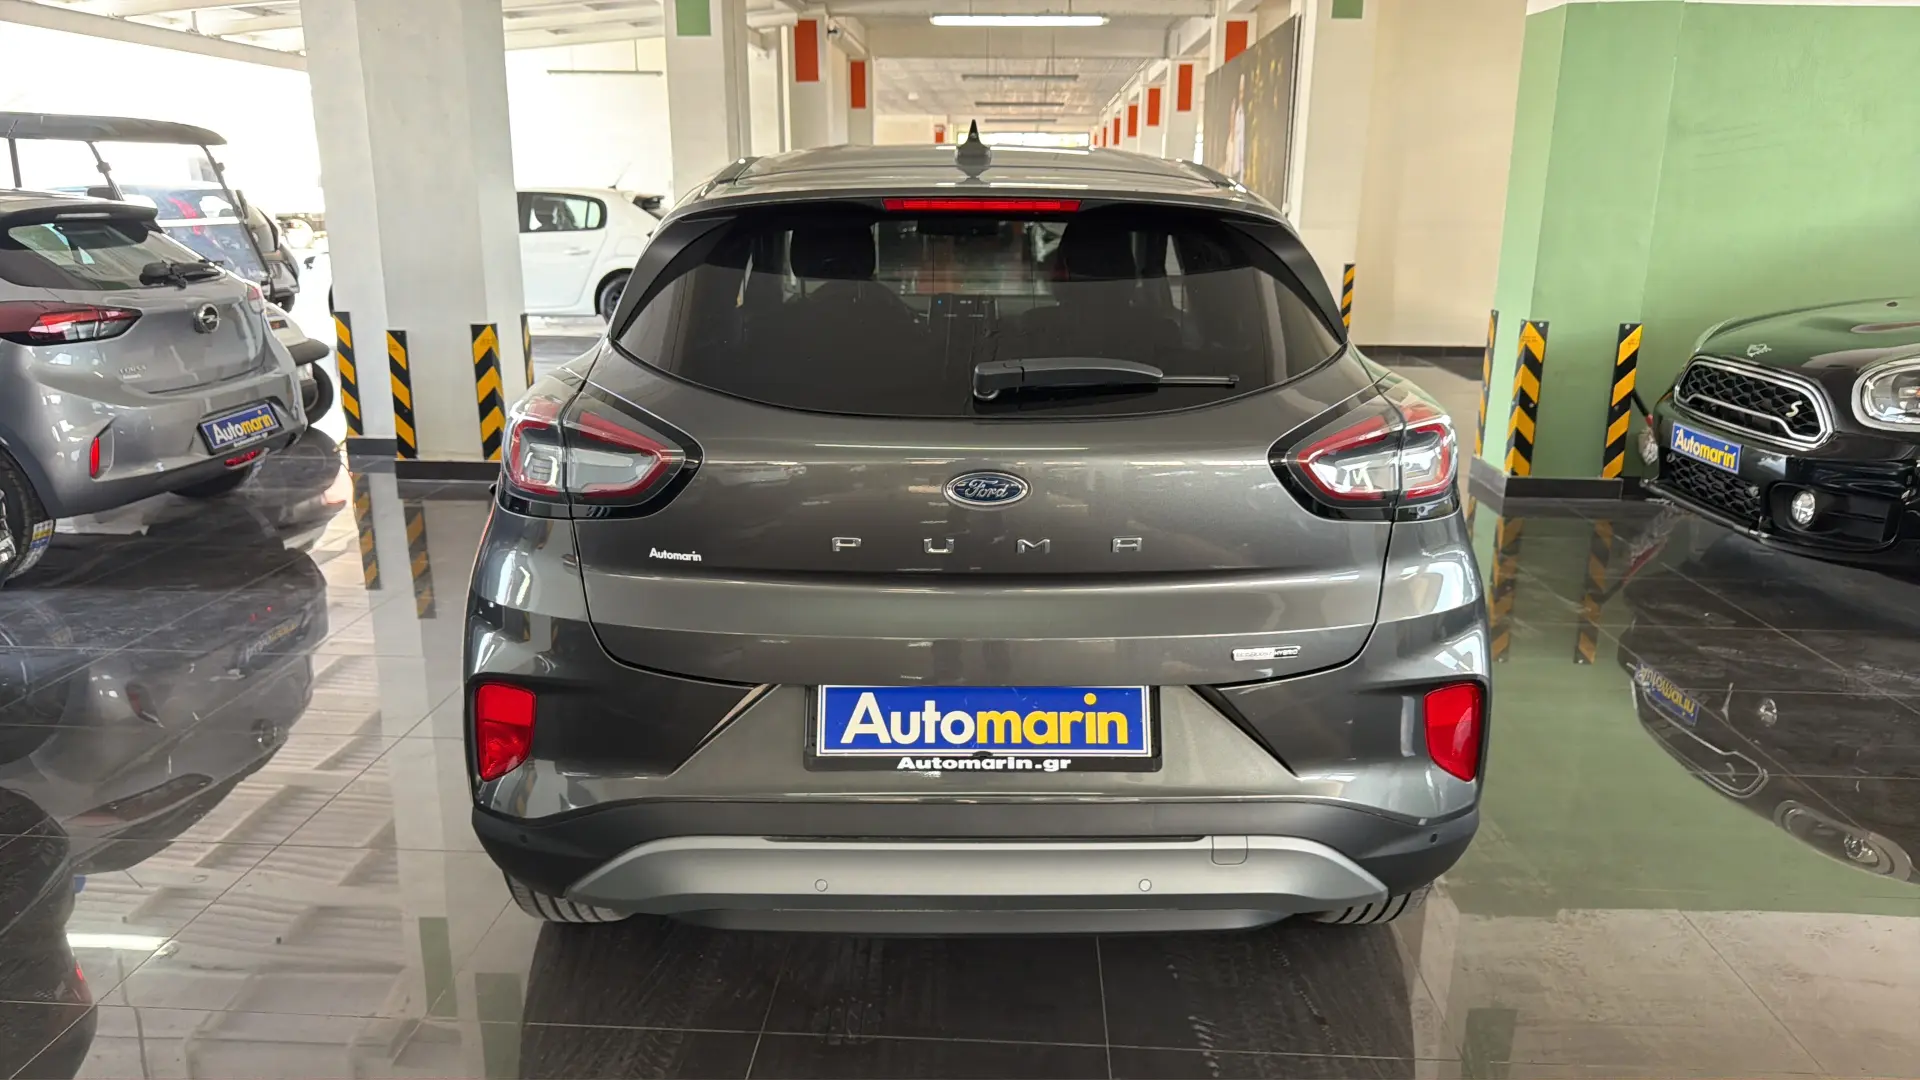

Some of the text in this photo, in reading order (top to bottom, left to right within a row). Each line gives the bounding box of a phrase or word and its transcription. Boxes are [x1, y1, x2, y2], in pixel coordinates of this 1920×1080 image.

[212, 409, 274, 445] Automarin
[1674, 428, 1736, 469] Automarin
[964, 479, 1009, 499] Ford
[648, 547, 702, 562] Automarin
[831, 536, 1143, 554] PUMA
[840, 691, 1128, 745] Automarin
[896, 756, 1072, 772] Automarin.gr
